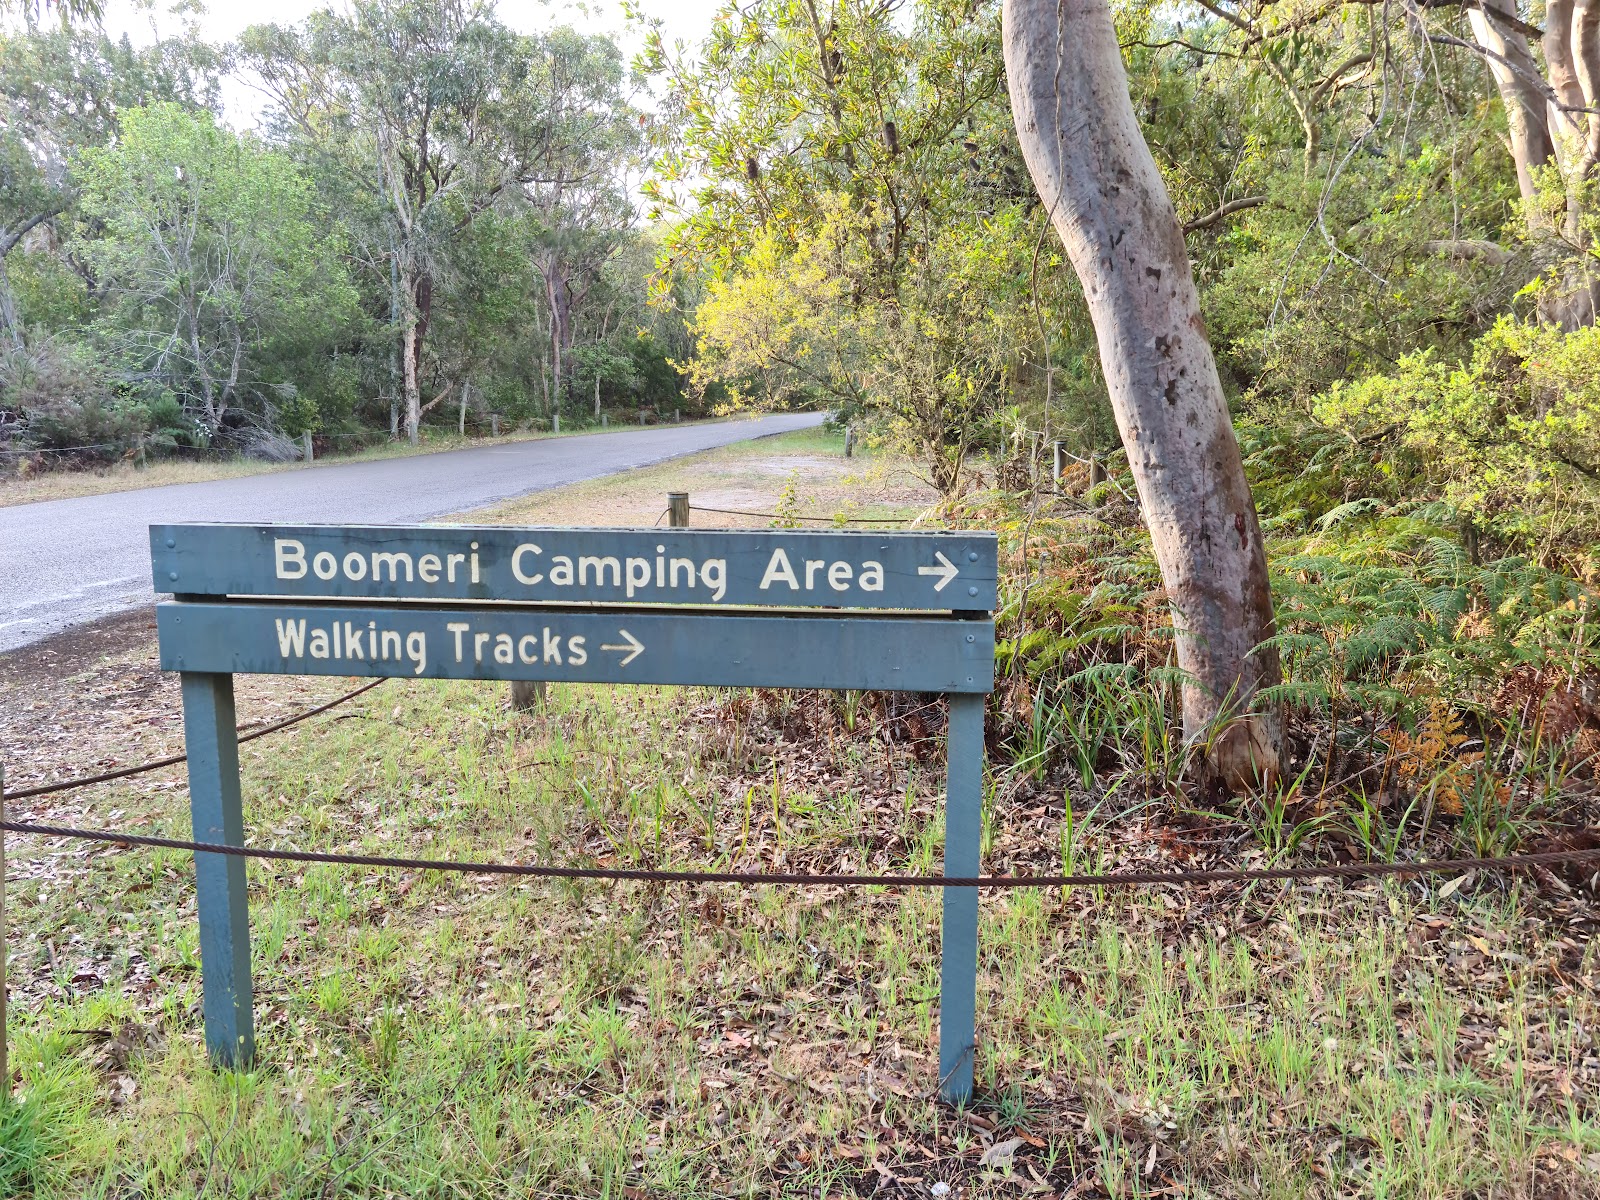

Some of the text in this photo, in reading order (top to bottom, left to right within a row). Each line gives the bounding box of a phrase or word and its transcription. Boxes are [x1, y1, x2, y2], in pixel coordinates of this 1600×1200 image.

[274, 537, 884, 601] Boomeri Camping Area
[275, 618, 588, 674] Walking Tracks
